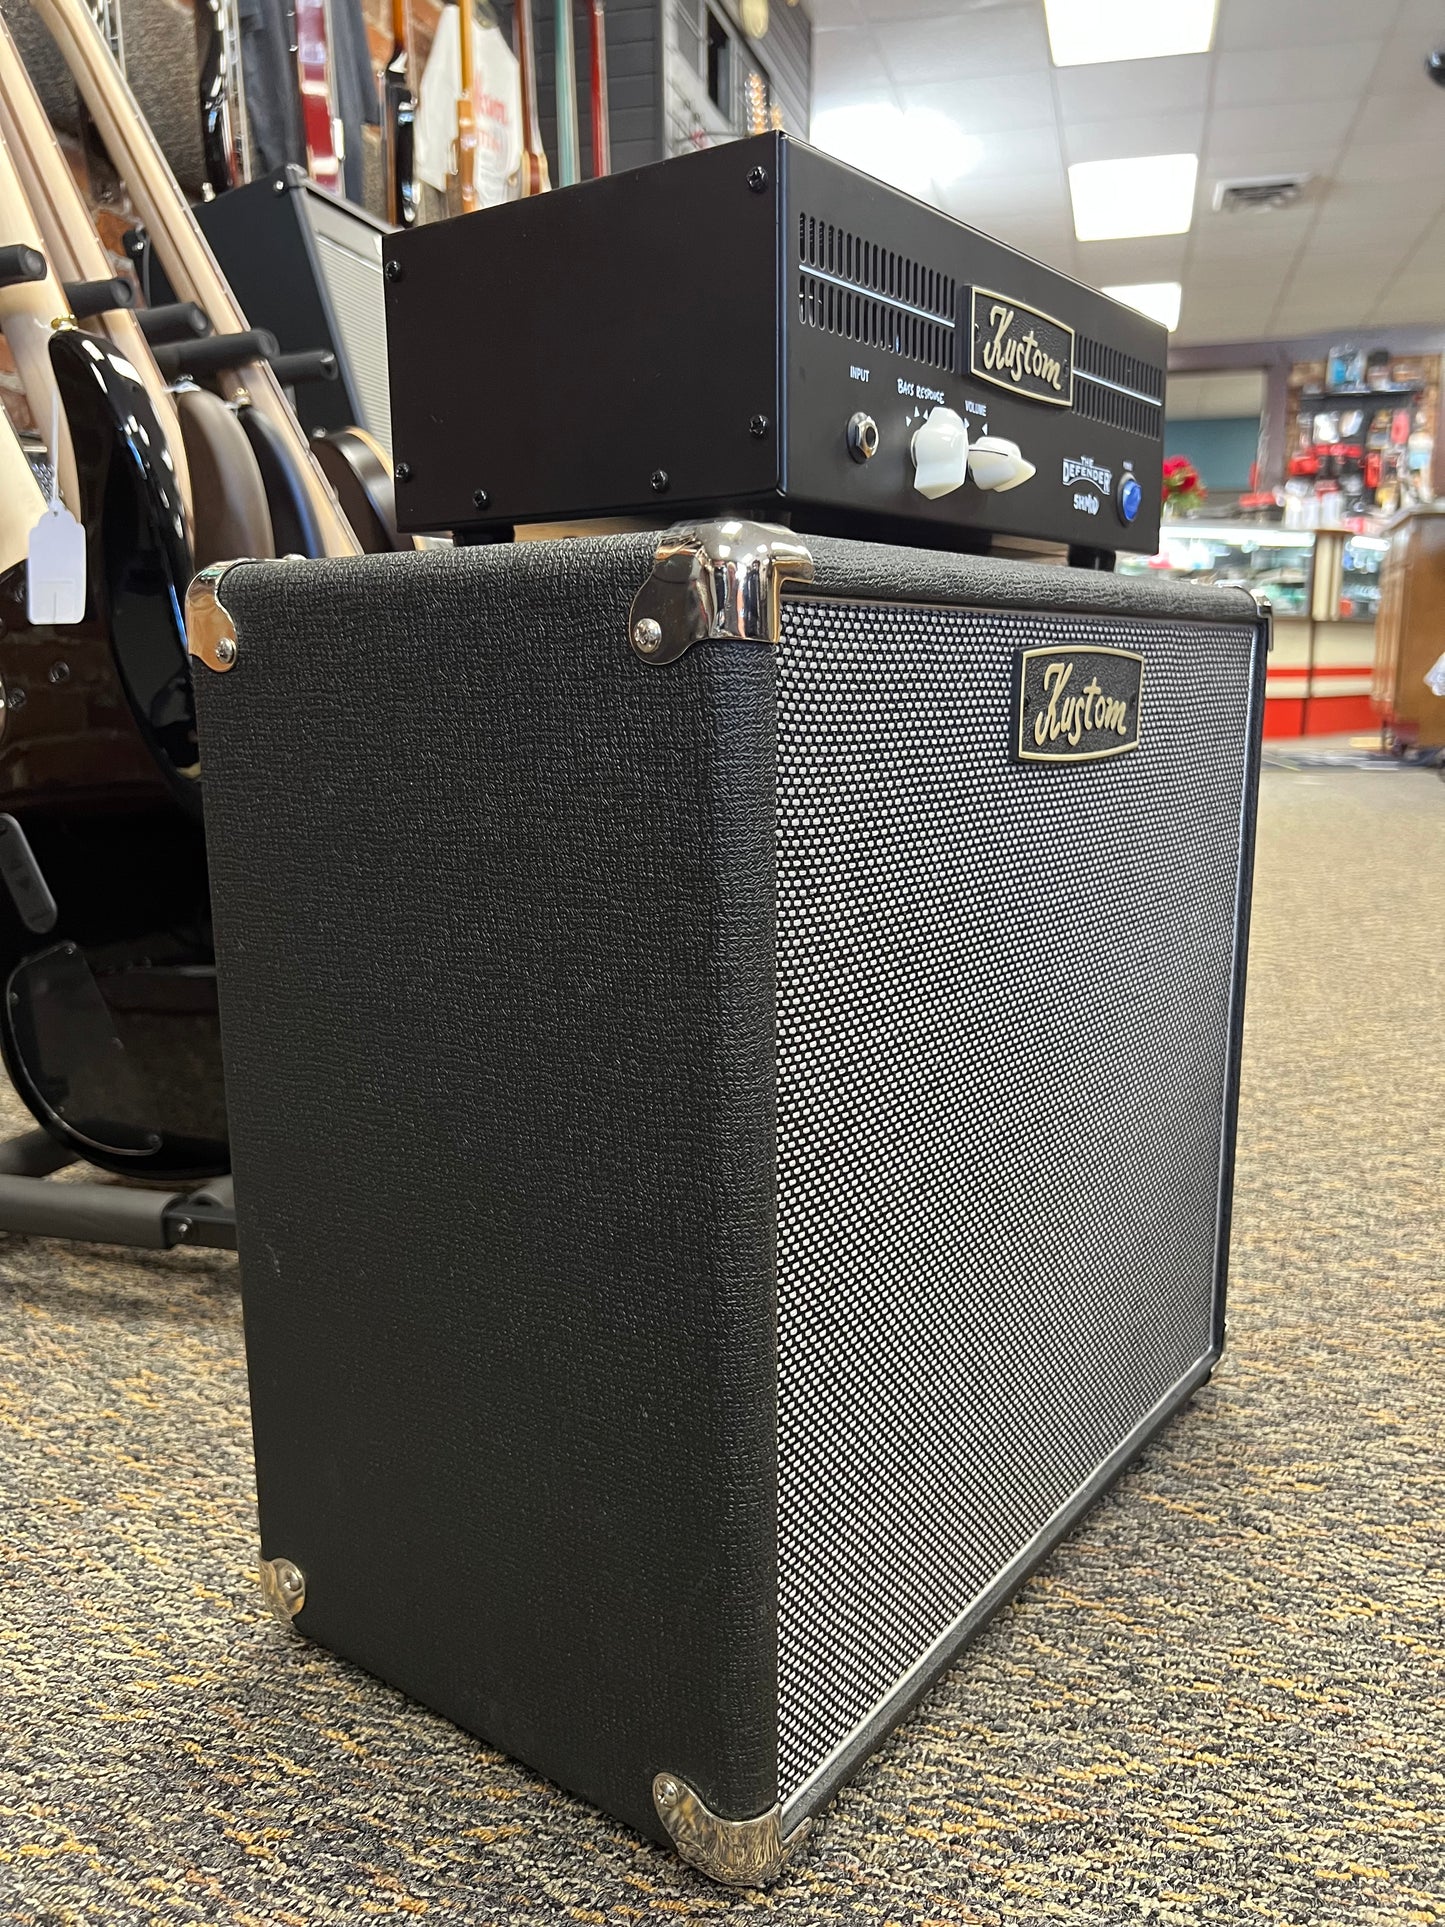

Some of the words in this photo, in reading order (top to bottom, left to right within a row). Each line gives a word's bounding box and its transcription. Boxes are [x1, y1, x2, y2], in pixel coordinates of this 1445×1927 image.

[983, 305, 1061, 391] Kustom
[849, 365, 870, 382] INPUT
[897, 378, 915, 397] BASS
[916, 385, 945, 404] RESPONSE
[964, 400, 987, 417] VOLUME
[1080, 456, 1094, 466] THE
[1062, 460, 1111, 494] DEFENDER
[1034, 662, 1127, 746] Kustom
